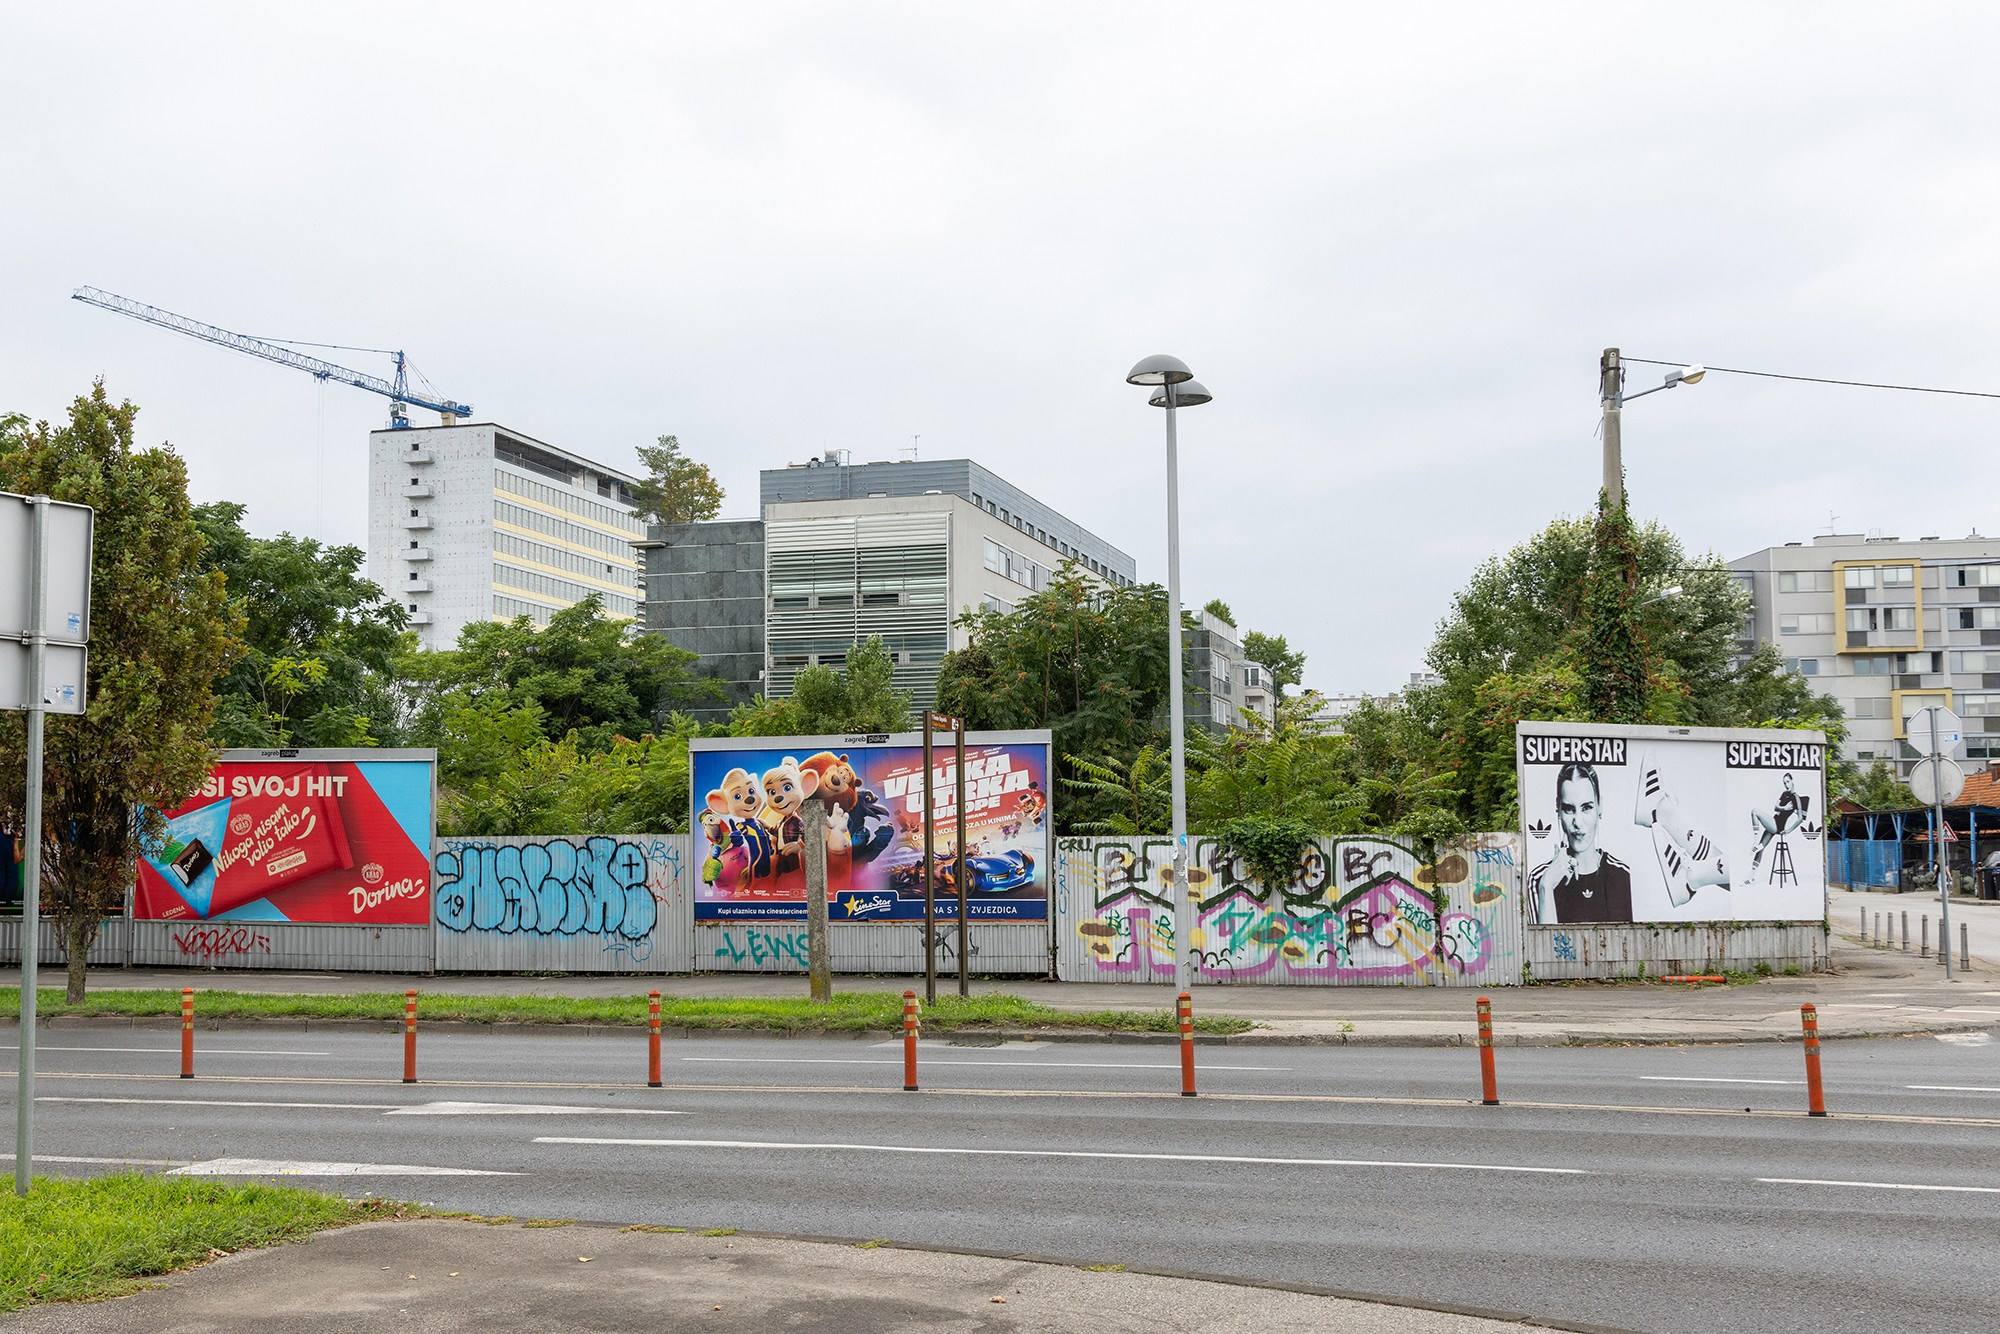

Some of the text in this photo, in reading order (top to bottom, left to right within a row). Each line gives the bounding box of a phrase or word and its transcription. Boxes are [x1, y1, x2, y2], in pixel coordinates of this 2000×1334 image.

[844, 735, 866, 744] zagreb
[1525, 737, 1624, 762] SUPERSTAR
[1728, 742, 1820, 767] SUPERSTAR
[231, 776, 300, 797] SVOJ
[307, 776, 348, 797] HIT
[883, 753, 1011, 799] VELIKA
[906, 769, 1030, 813] UTRKA
[987, 813, 1018, 825] KINIMA
[212, 837, 254, 878] Nikoga
[254, 803, 290, 839] nisam
[246, 837, 275, 867] volio
[274, 814, 300, 841] tako
[348, 878, 414, 914] Dorina
[162, 905, 186, 918] LEDENA
[717, 907, 732, 916] Kupi
[732, 907, 757, 915] ulaznicu
[970, 906, 1018, 914] ZVJEZDICA
